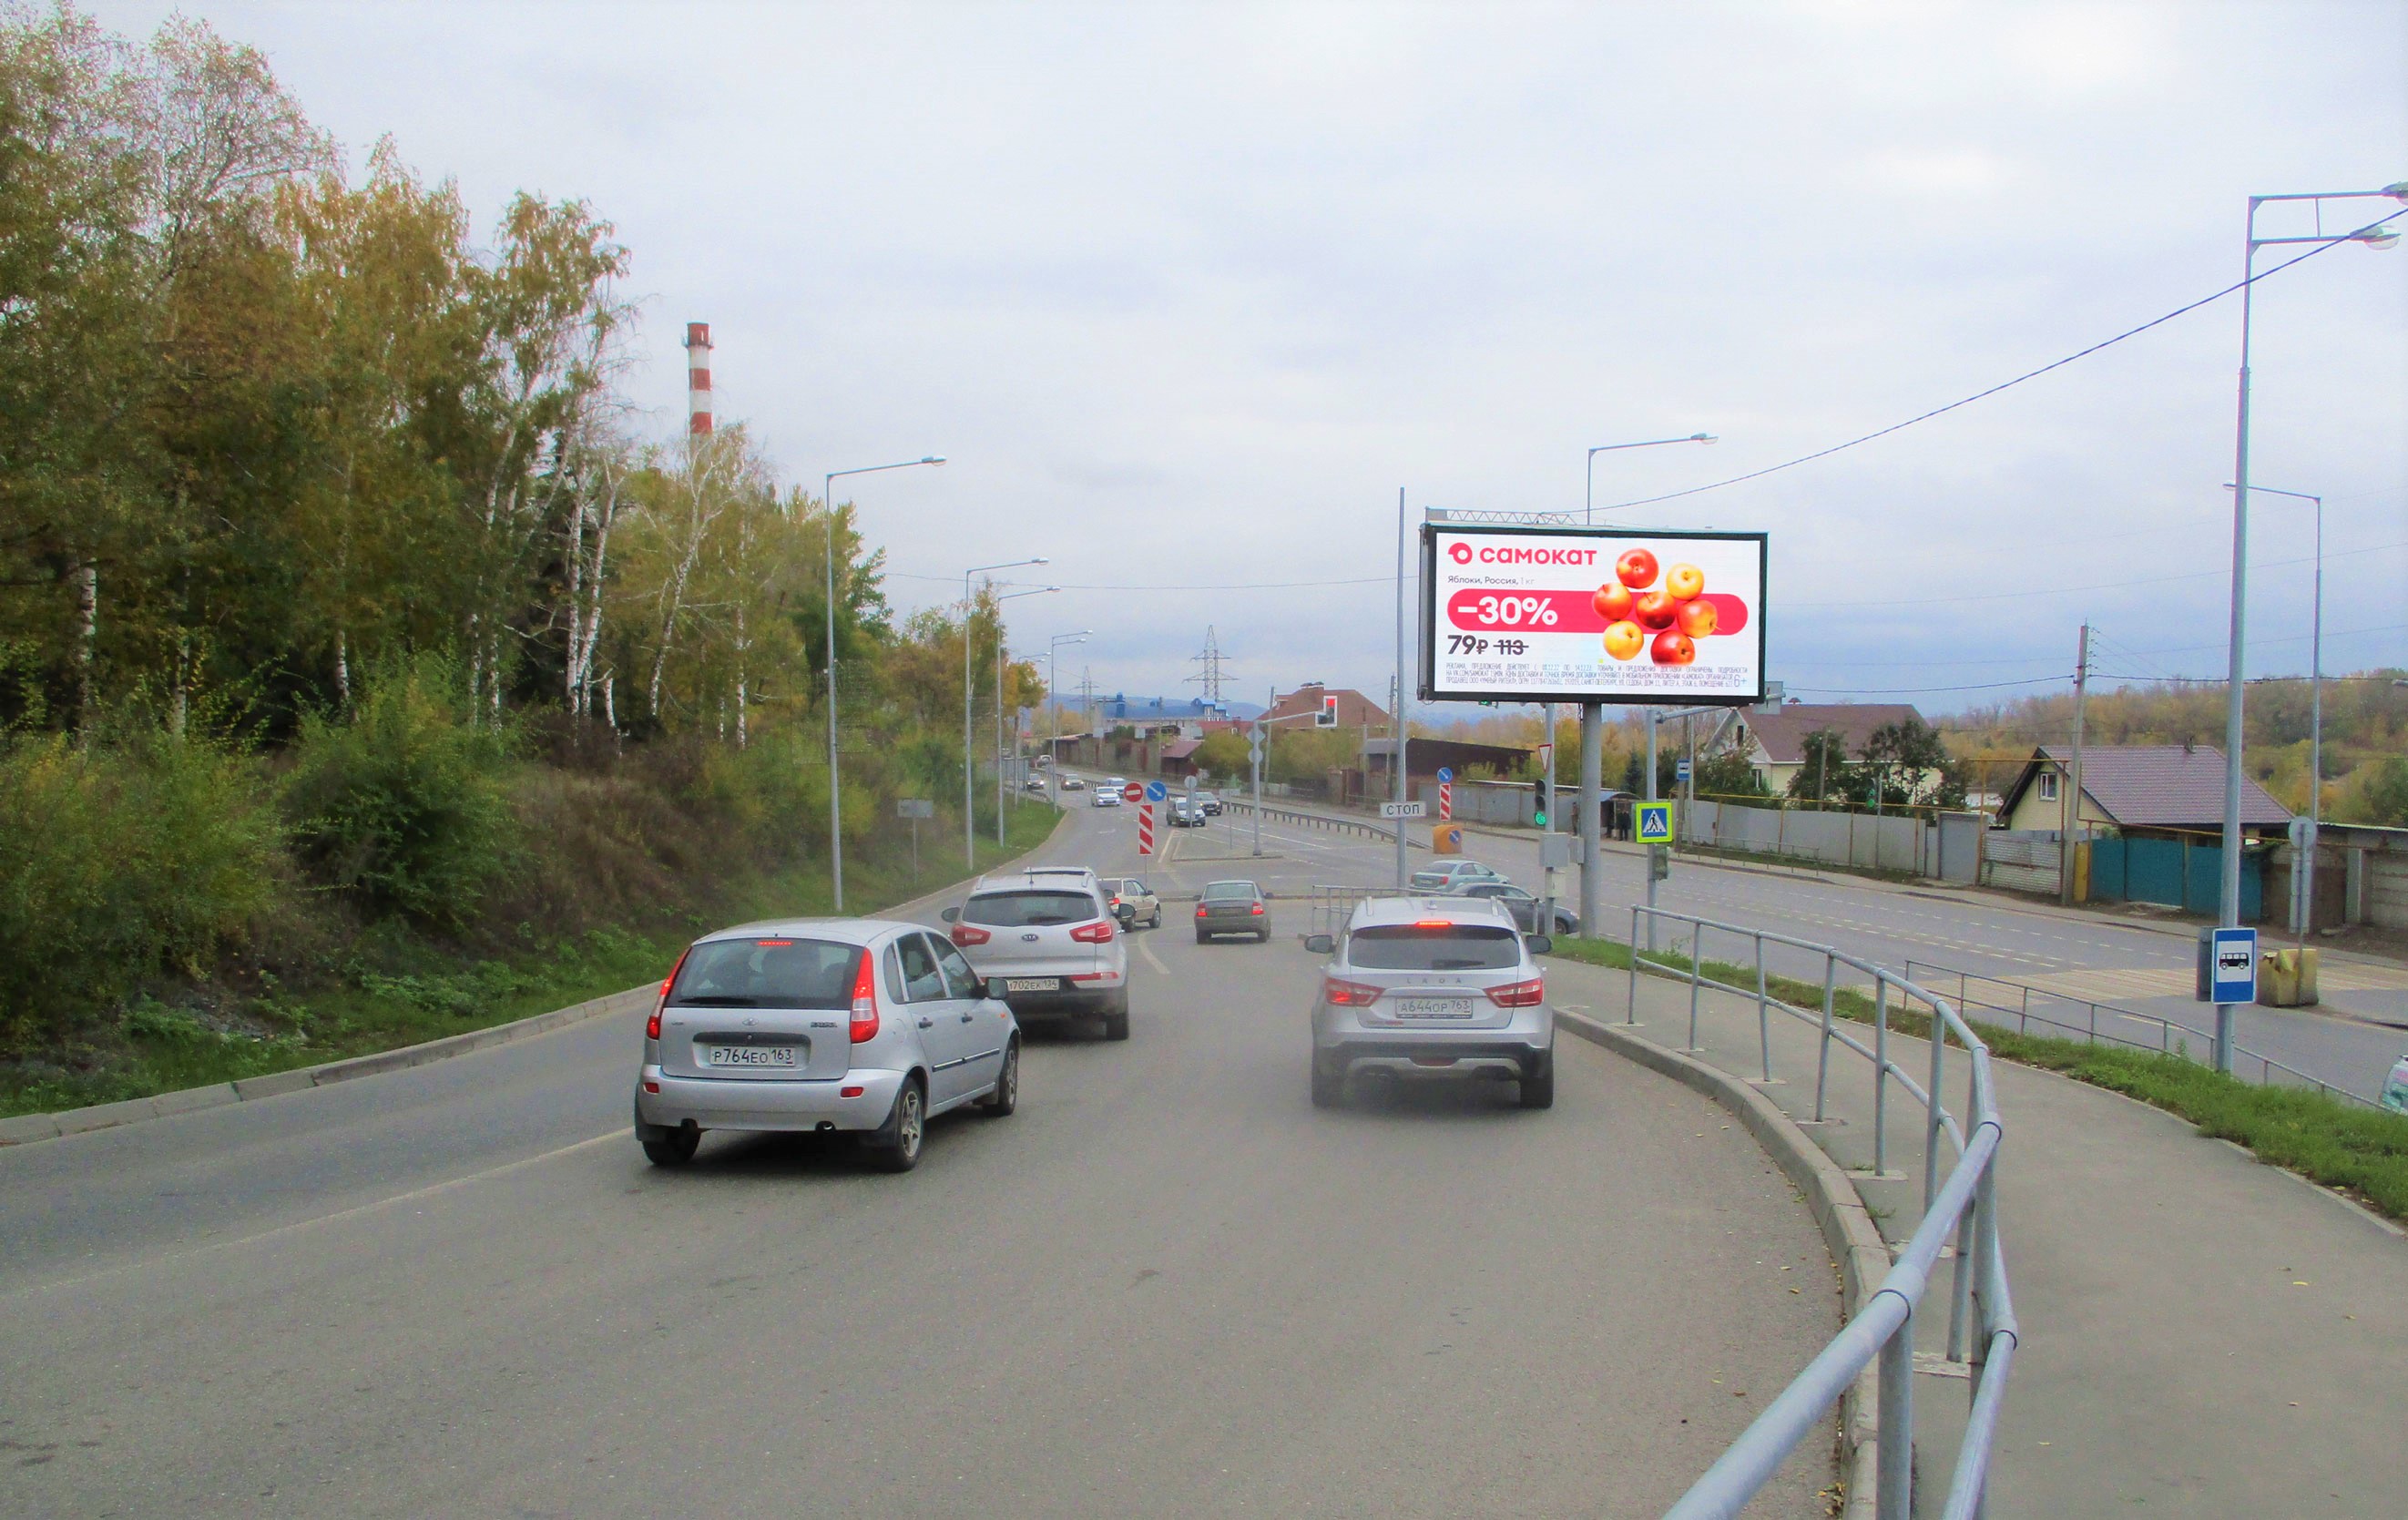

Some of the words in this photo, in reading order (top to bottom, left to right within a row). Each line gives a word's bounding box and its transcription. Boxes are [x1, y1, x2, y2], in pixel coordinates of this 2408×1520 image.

[1479, 547, 1597, 566] самокат
[1447, 576, 1483, 585] Яблоки,
[1485, 576, 1519, 586] Россия,
[1495, 639, 1527, 656] 113
[1386, 804, 1420, 815] СТОП
[713, 1048, 769, 1064] Р764ЕО
[770, 1048, 791, 1061] 163
